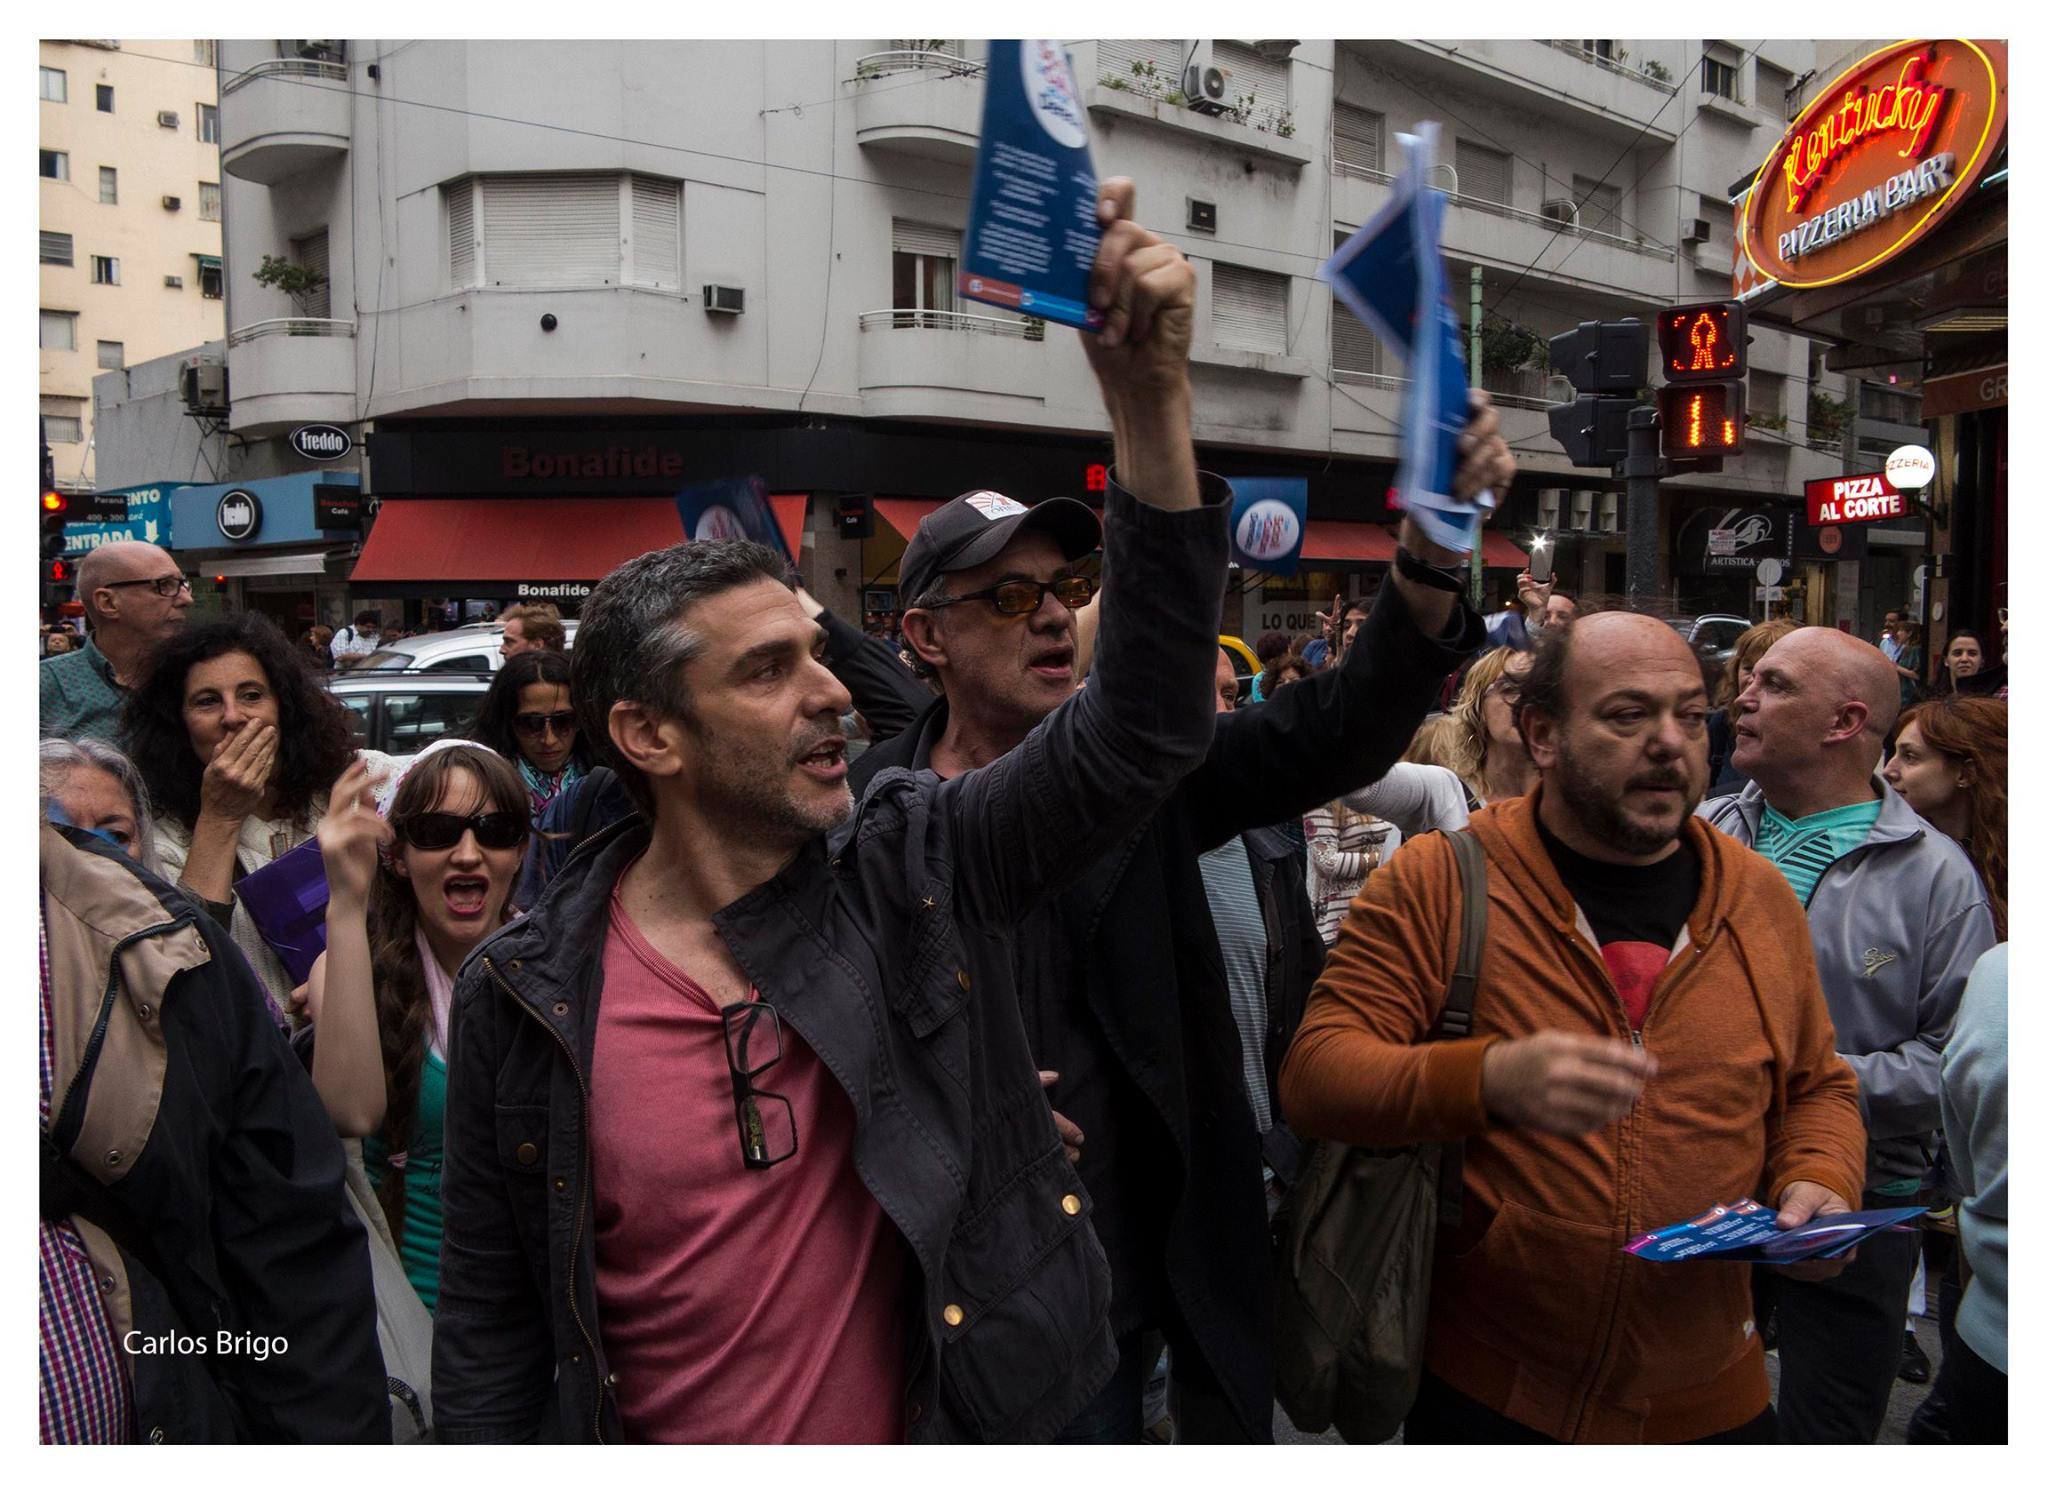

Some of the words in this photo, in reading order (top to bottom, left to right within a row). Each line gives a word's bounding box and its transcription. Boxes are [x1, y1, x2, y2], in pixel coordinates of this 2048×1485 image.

[1783, 54, 1942, 213] Kentucky
[1778, 188, 1886, 262] PIZZERIA
[1884, 151, 1956, 209] BAR
[301, 431, 343, 451] freddo
[501, 446, 683, 478] Bonafide
[1833, 476, 1884, 501] PIZZA
[1819, 502, 1841, 521] AL
[1843, 494, 1901, 519] CORTE
[64, 529, 134, 551] ENTRADA
[1711, 556, 1755, 567] ARTISTICA
[518, 584, 590, 596] Bonafide
[1262, 613, 1282, 630] LO
[1286, 613, 1317, 630] QUE
